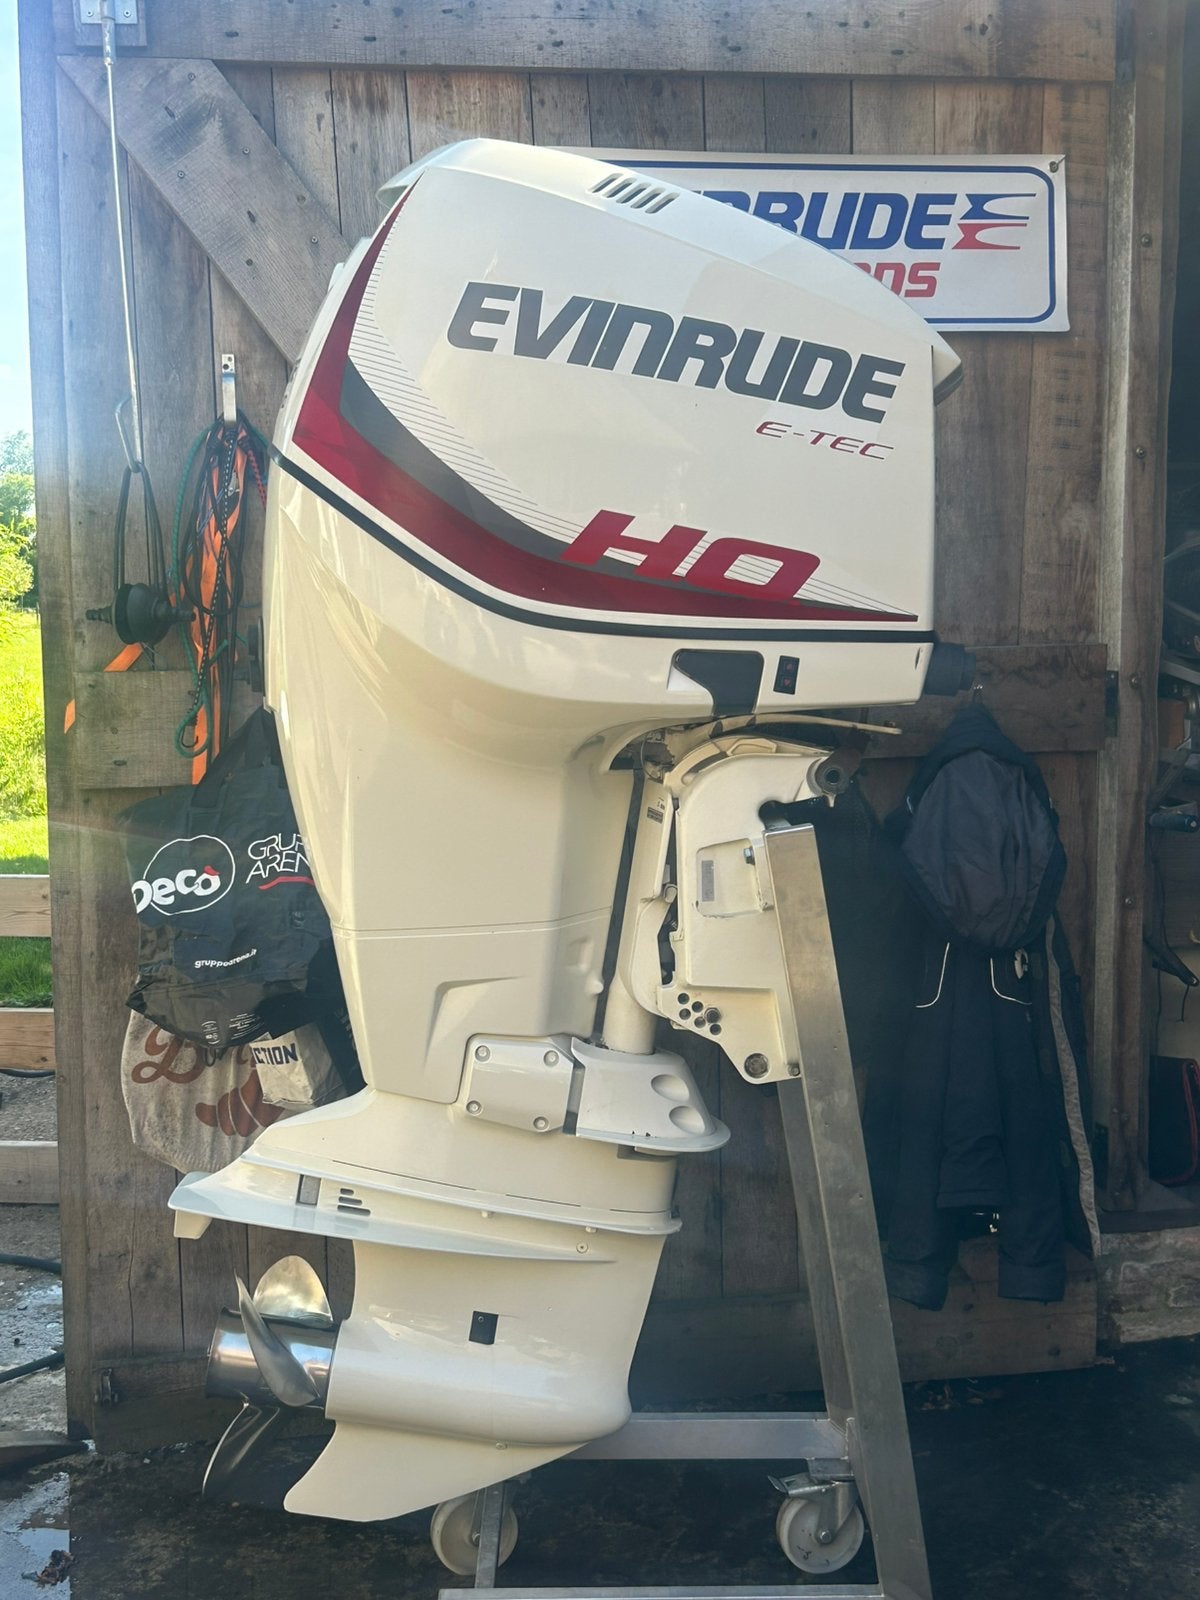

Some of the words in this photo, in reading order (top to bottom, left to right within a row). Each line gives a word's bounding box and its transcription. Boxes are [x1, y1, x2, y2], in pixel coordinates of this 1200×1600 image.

[692, 190, 957, 250] RUDE
[447, 281, 906, 423] EVINRUDE
[756, 420, 894, 460] E-TEC
[194, 948, 257, 968] gruppoarena.it
